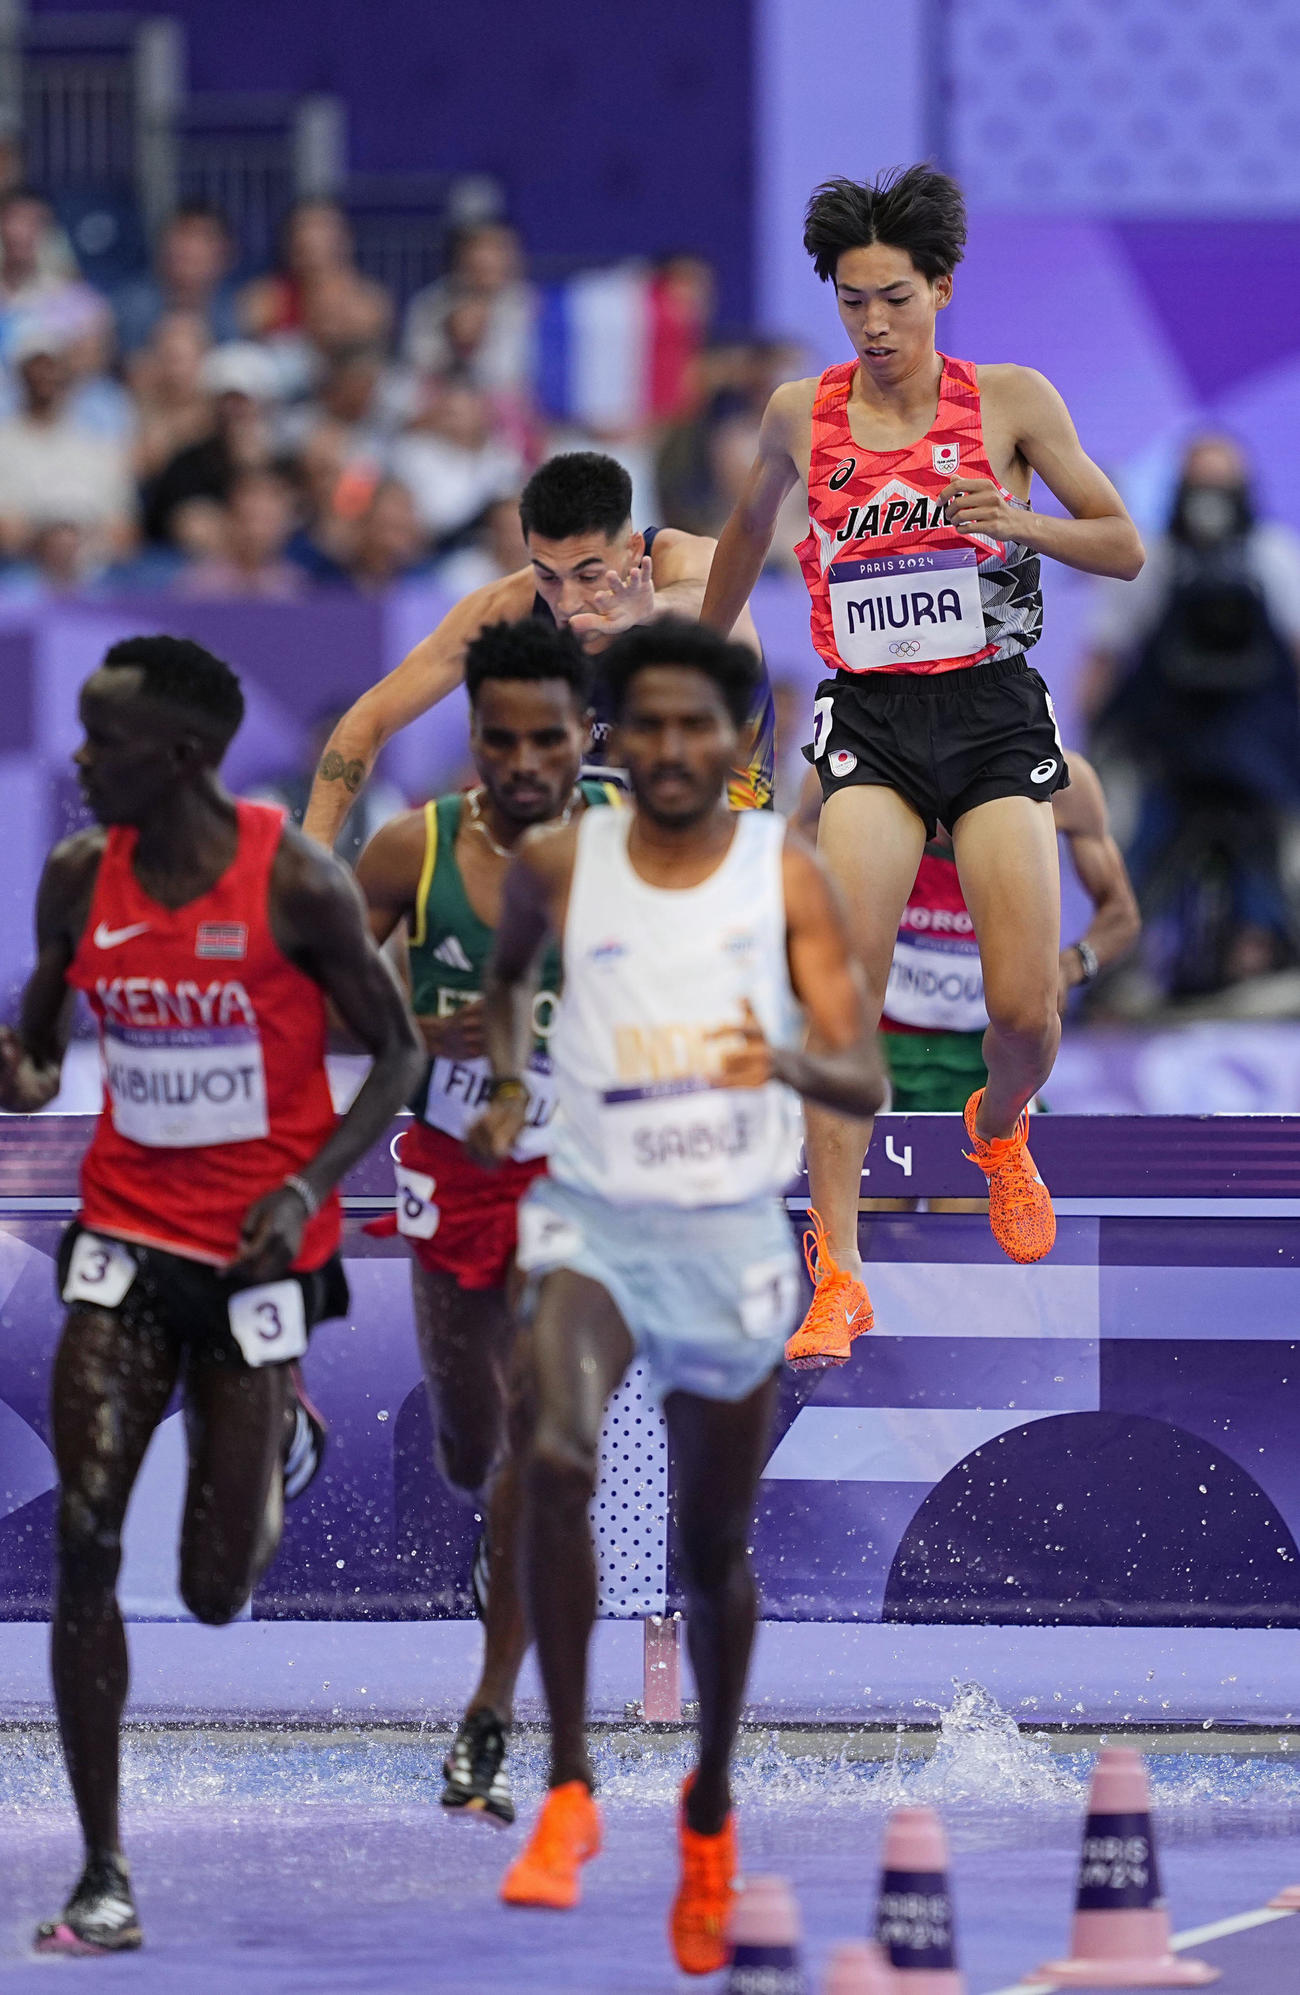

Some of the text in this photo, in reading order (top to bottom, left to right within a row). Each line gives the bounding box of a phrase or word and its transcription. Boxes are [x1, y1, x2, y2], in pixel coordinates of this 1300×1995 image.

[860, 556, 934, 574] PARIS 2024
[847, 588, 962, 634] MIURA
[96, 977, 259, 1027] KENYA
[80, 1250, 111, 1283] 3
[255, 1301, 282, 1340] 3
